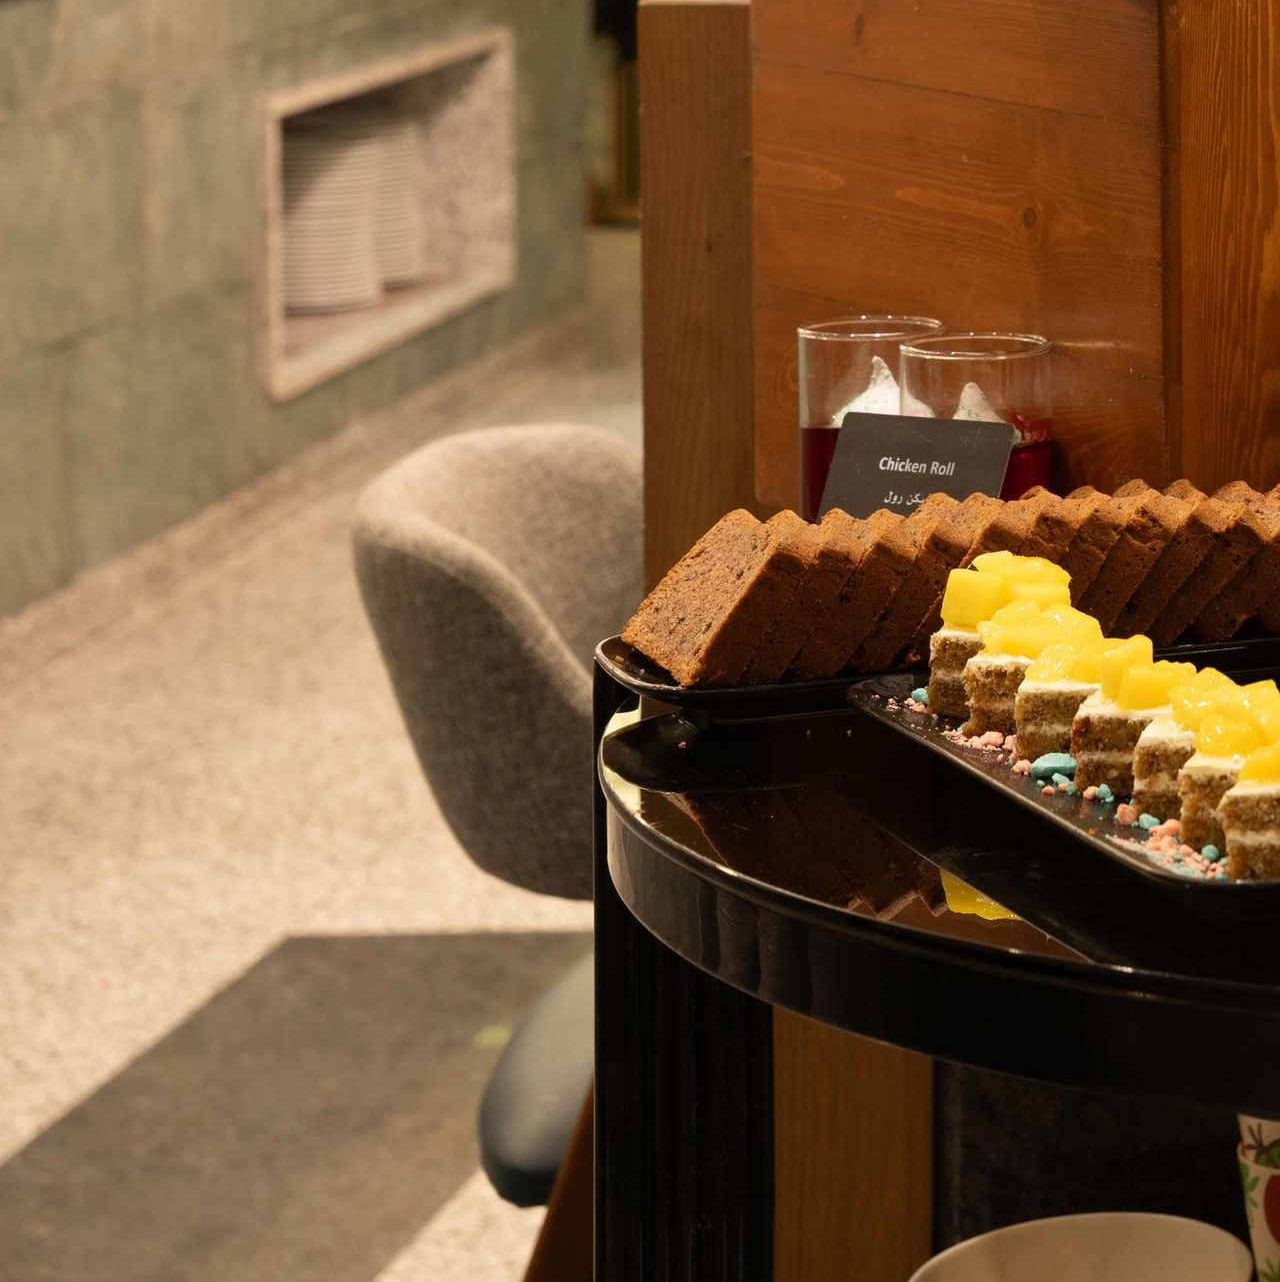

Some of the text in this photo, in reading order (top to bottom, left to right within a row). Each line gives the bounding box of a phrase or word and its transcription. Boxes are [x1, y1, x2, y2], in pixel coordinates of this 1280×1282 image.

[878, 456, 955, 476] Chicken Roll
[883, 490, 904, 505] رول
